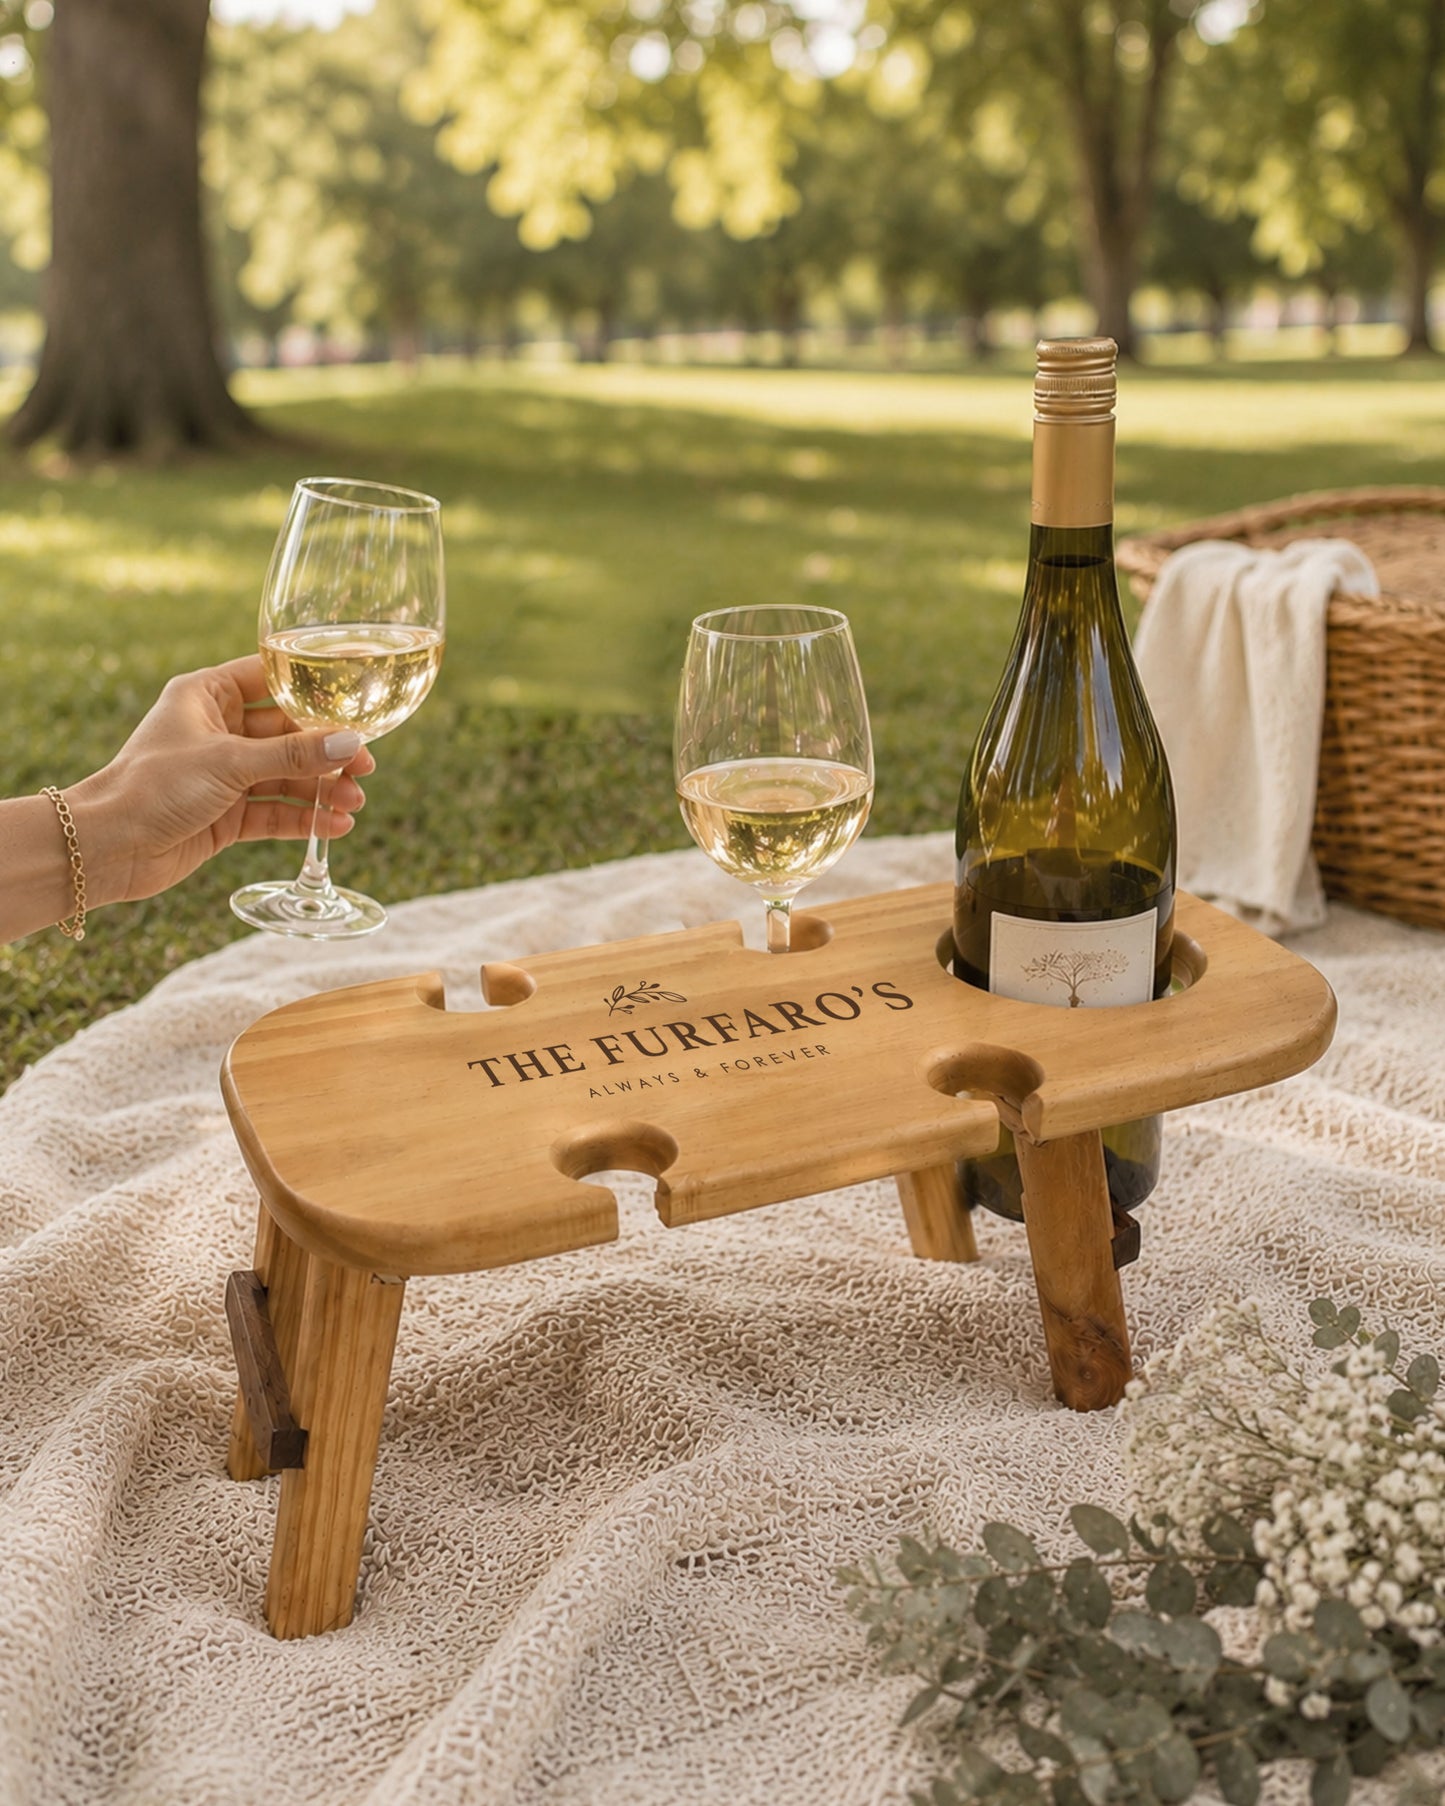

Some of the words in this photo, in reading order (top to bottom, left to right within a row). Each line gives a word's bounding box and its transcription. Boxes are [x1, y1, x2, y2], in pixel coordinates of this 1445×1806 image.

[467, 1043, 586, 1088] THE
[589, 981, 914, 1066] FURFARO’S
[589, 1072, 680, 1099] ALWAYS
[693, 1067, 709, 1079] &
[719, 1044, 831, 1074] FOREVER
